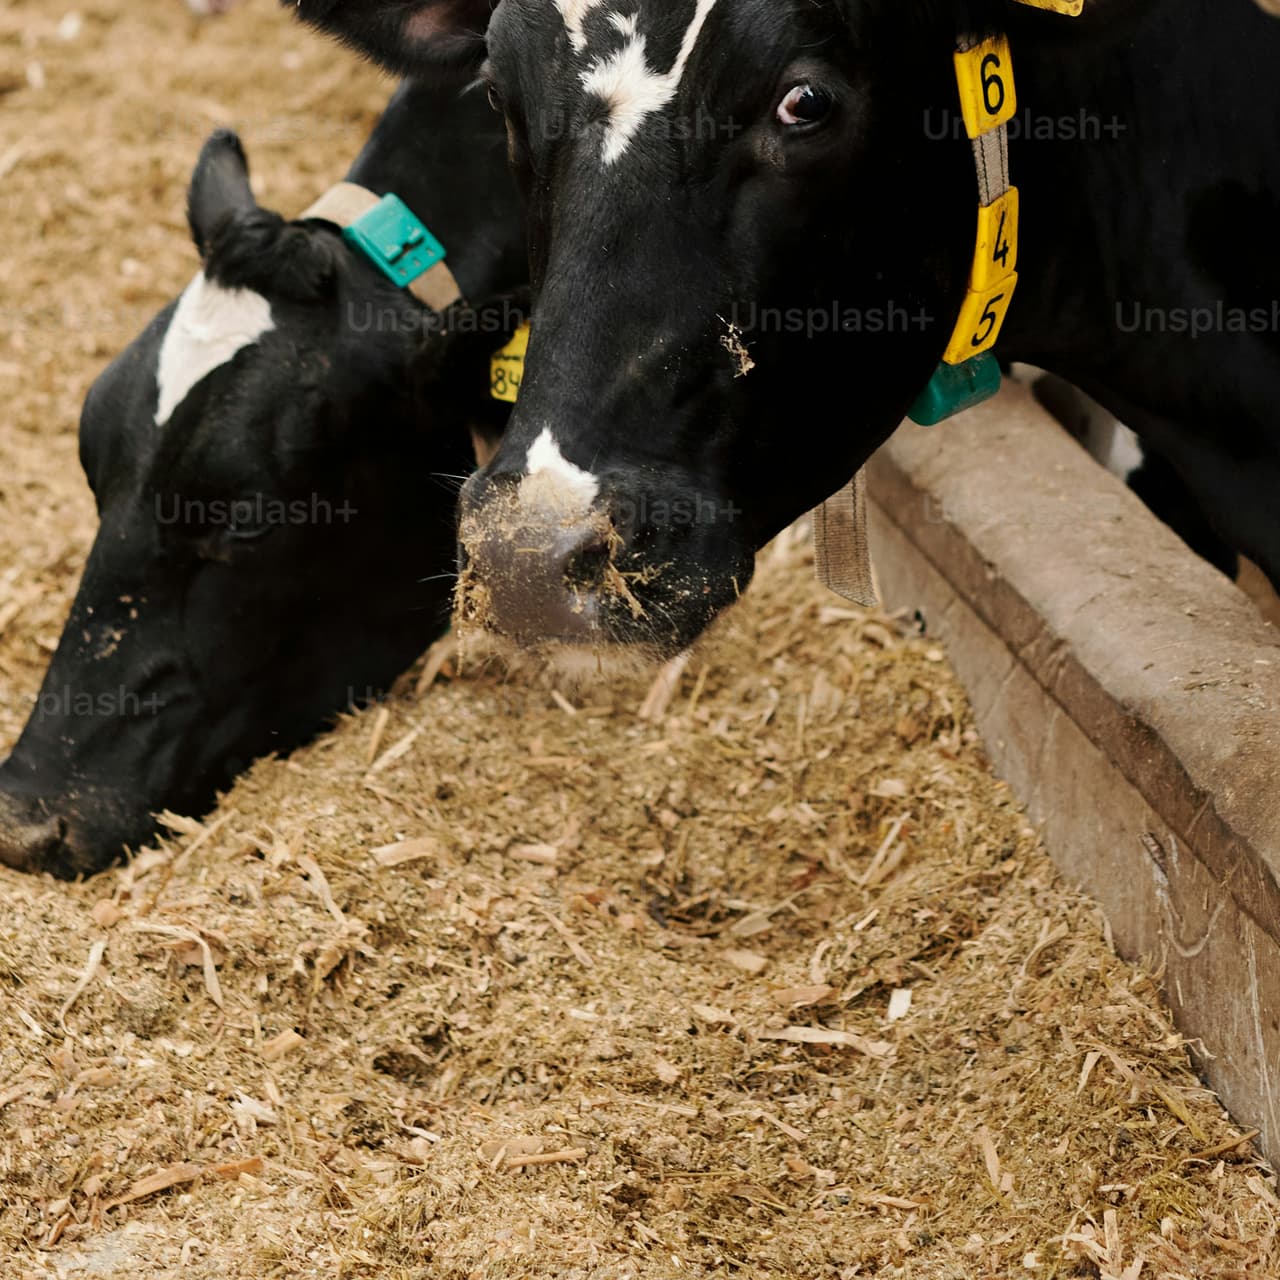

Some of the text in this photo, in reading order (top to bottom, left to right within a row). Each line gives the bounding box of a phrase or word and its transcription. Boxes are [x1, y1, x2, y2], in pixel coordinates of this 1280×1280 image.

[971, 52, 1009, 348] 6 4 5
